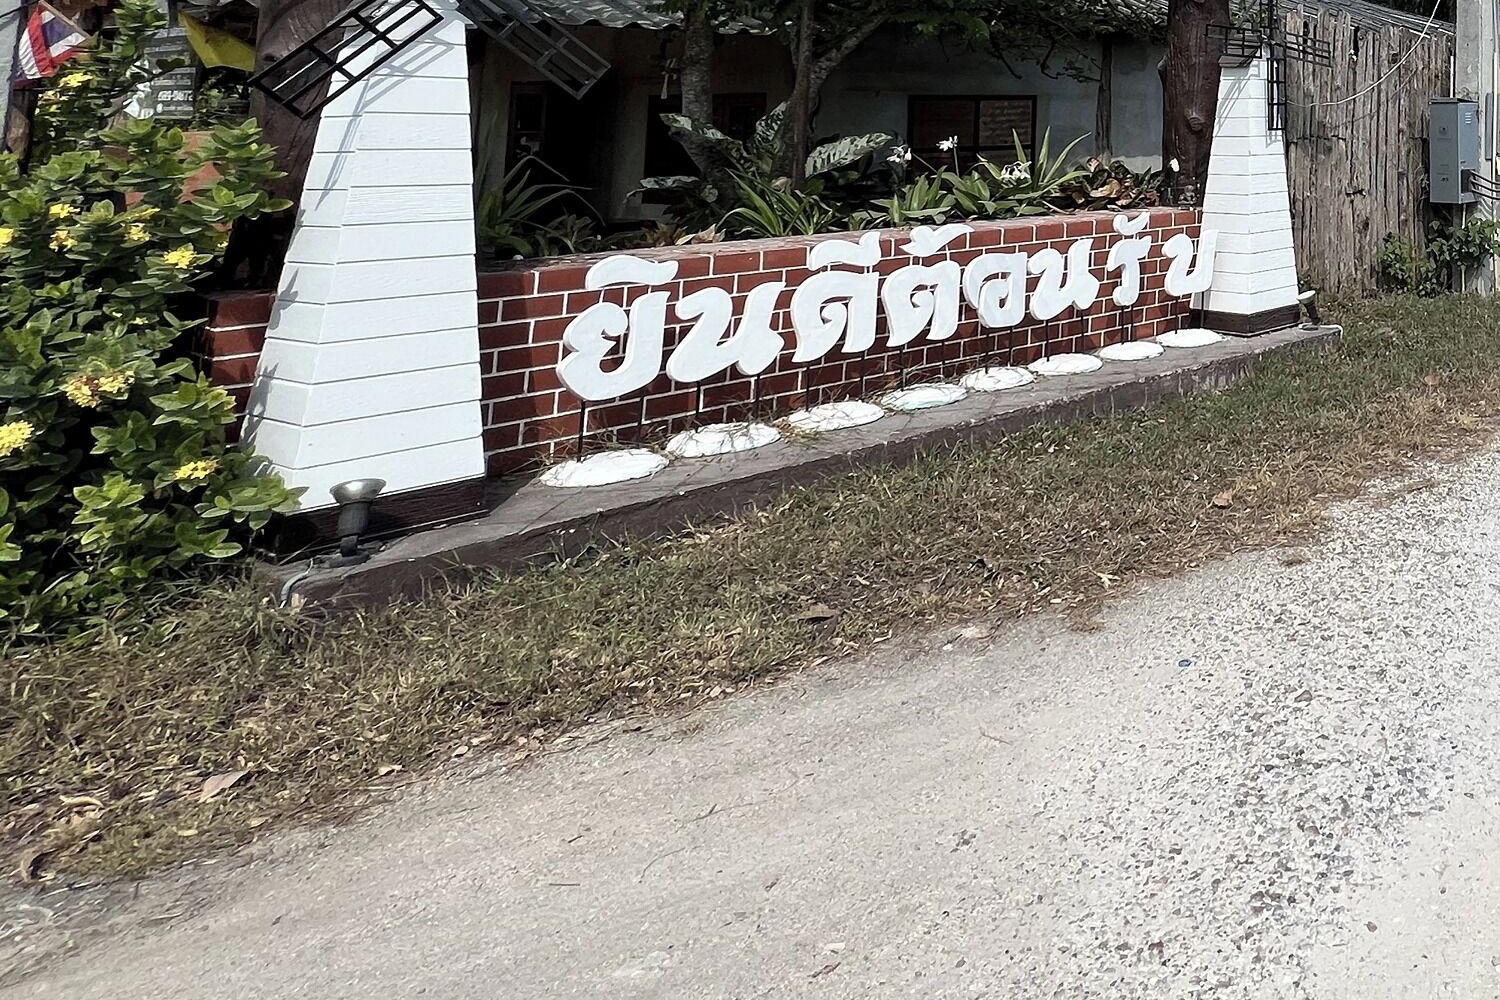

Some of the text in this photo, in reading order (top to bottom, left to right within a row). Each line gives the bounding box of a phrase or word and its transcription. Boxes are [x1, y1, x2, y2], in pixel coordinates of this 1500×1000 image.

[556, 211, 1219, 401] ยินดีต้อนรับ
